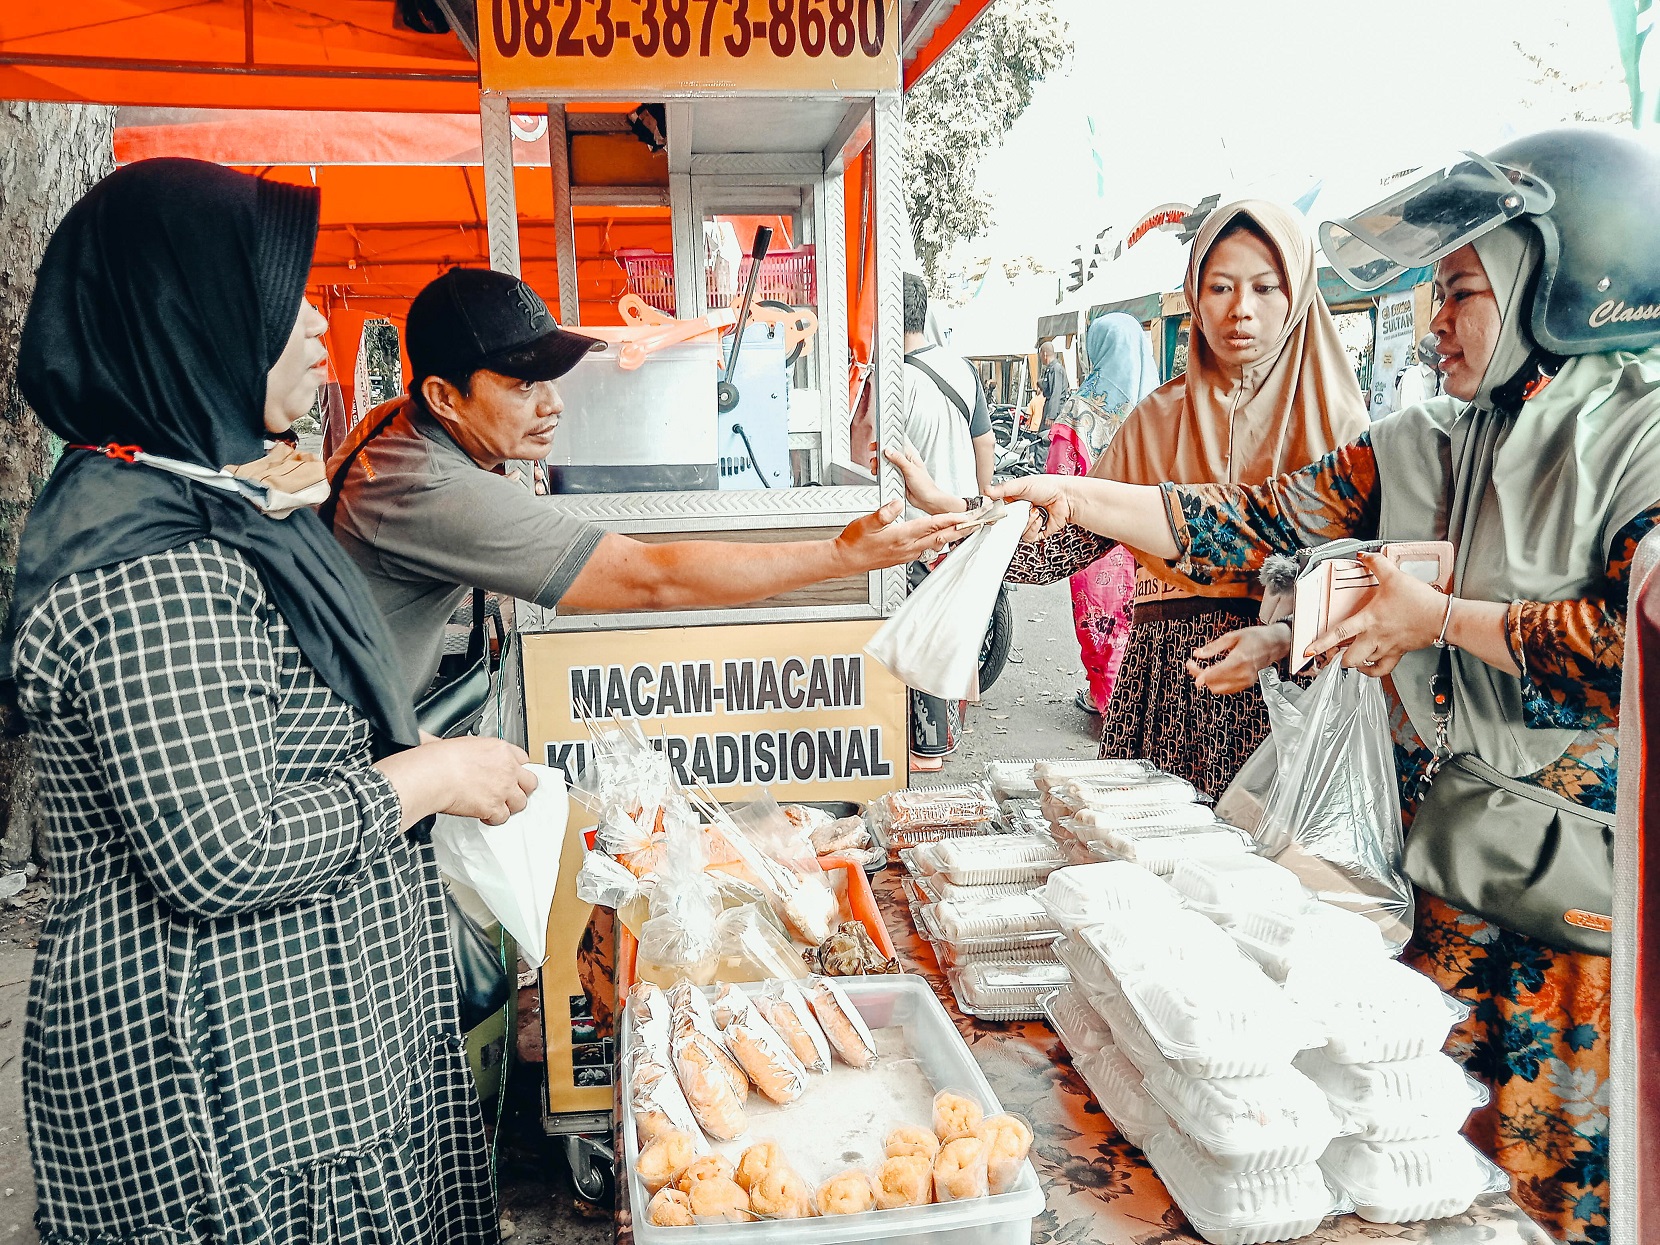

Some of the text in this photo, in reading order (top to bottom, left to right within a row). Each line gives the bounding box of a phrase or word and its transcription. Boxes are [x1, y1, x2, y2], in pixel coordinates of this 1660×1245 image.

[491, 0, 886, 59] 0823-3873-8680
[1382, 312, 1413, 335] SULTAN
[568, 656, 863, 720] MACAM-MACAM
